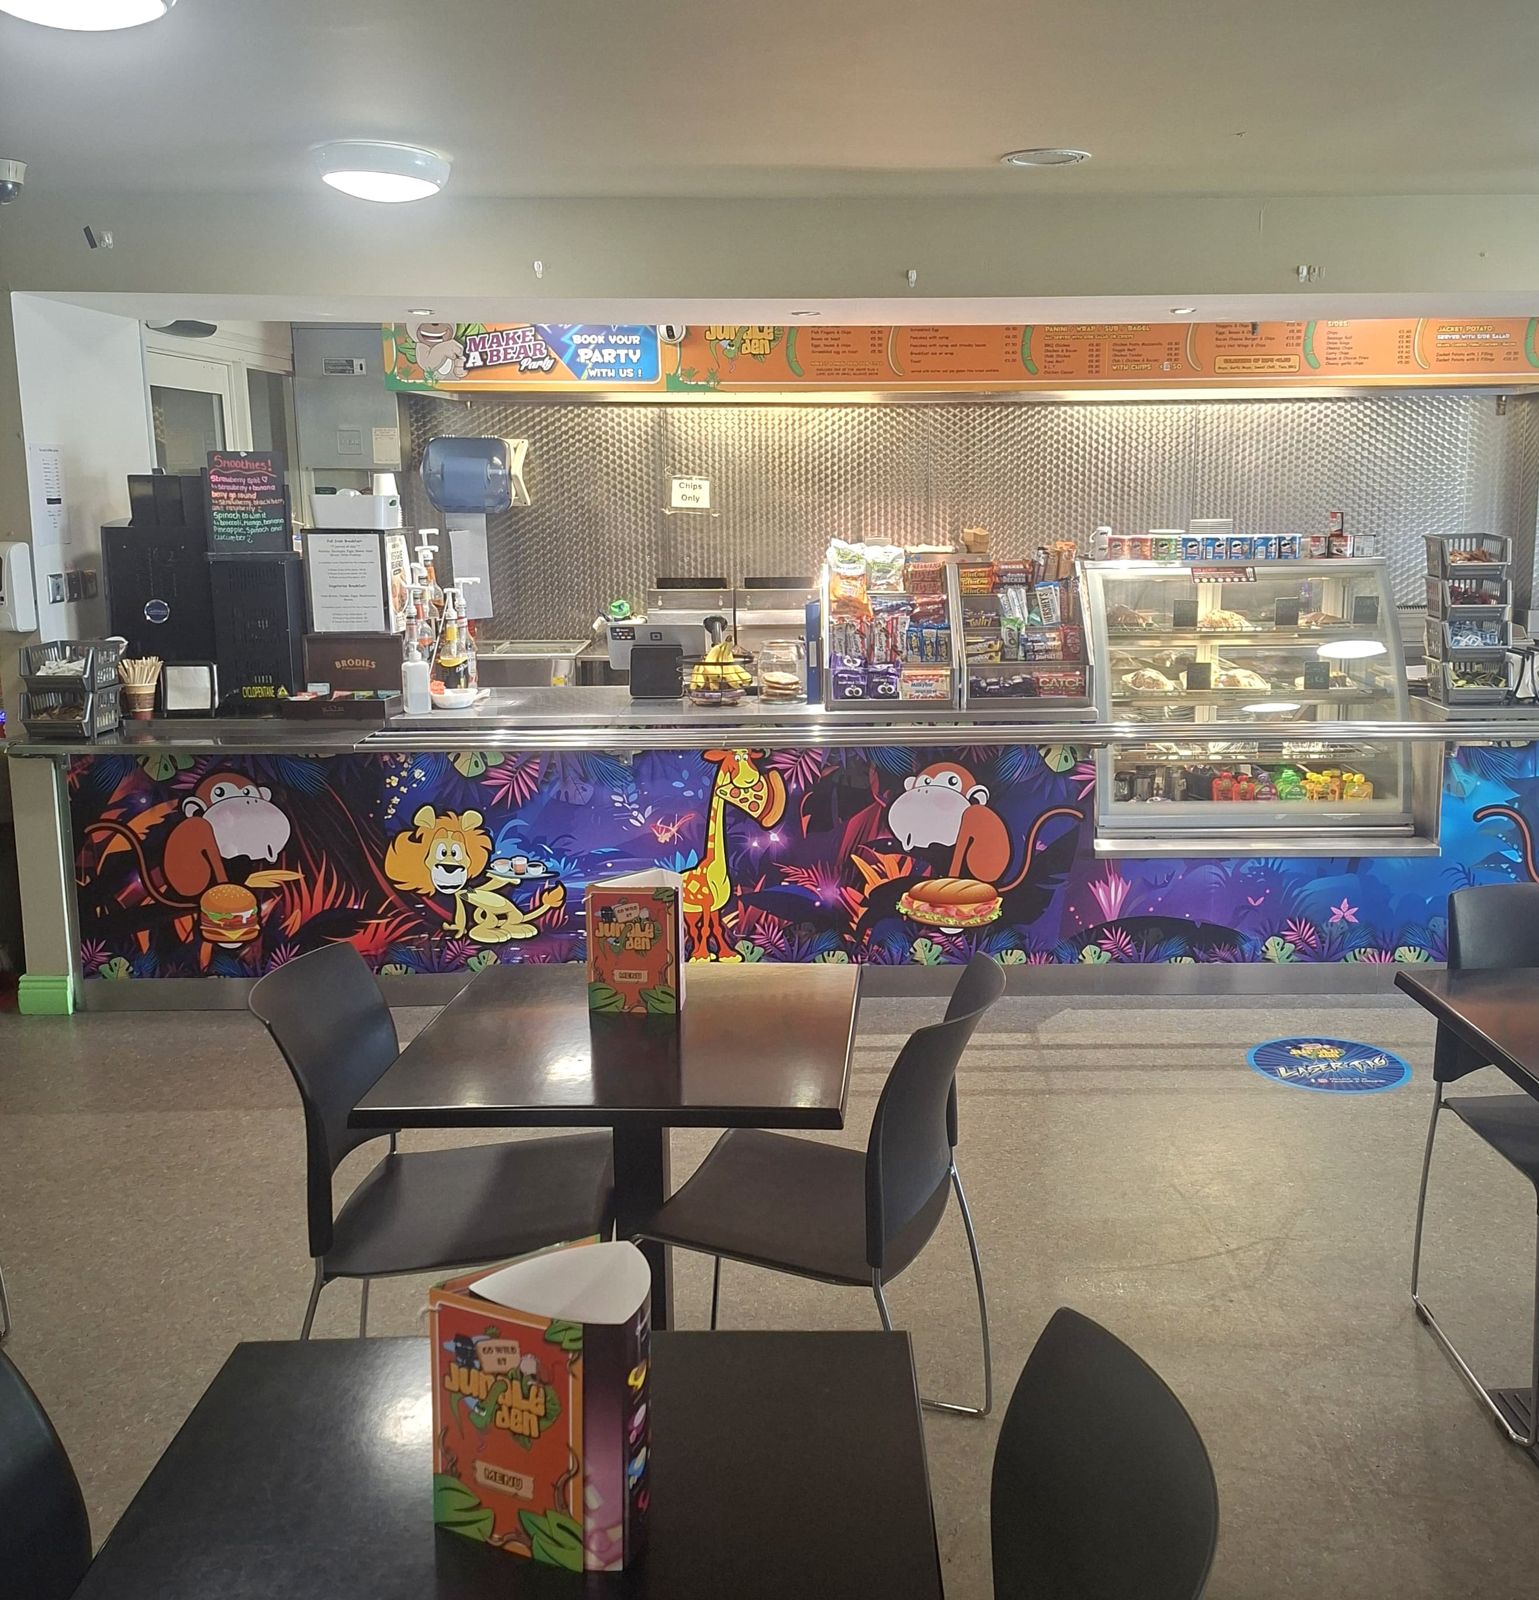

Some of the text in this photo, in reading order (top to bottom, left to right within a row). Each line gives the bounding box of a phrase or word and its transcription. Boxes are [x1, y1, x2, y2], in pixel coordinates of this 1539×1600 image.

[466, 329, 534, 352] MAKE
[572, 335, 640, 345] BOOK YOUR
[466, 343, 546, 368] A BEAR
[577, 349, 641, 363] PARTY
[520, 357, 554, 371] Party
[588, 368, 616, 377] WITH
[619, 368, 634, 377] US
[679, 482, 702, 490] Chips
[681, 494, 700, 503] Only
[334, 658, 377, 669] BRODIES
[1039, 678, 1085, 687] CATCH
[625, 937, 651, 950] den
[1276, 1060, 1344, 1079] LASER
[495, 1346, 517, 1355] WILD
[494, 1406, 541, 1440] den
[483, 1467, 524, 1491] MENU
